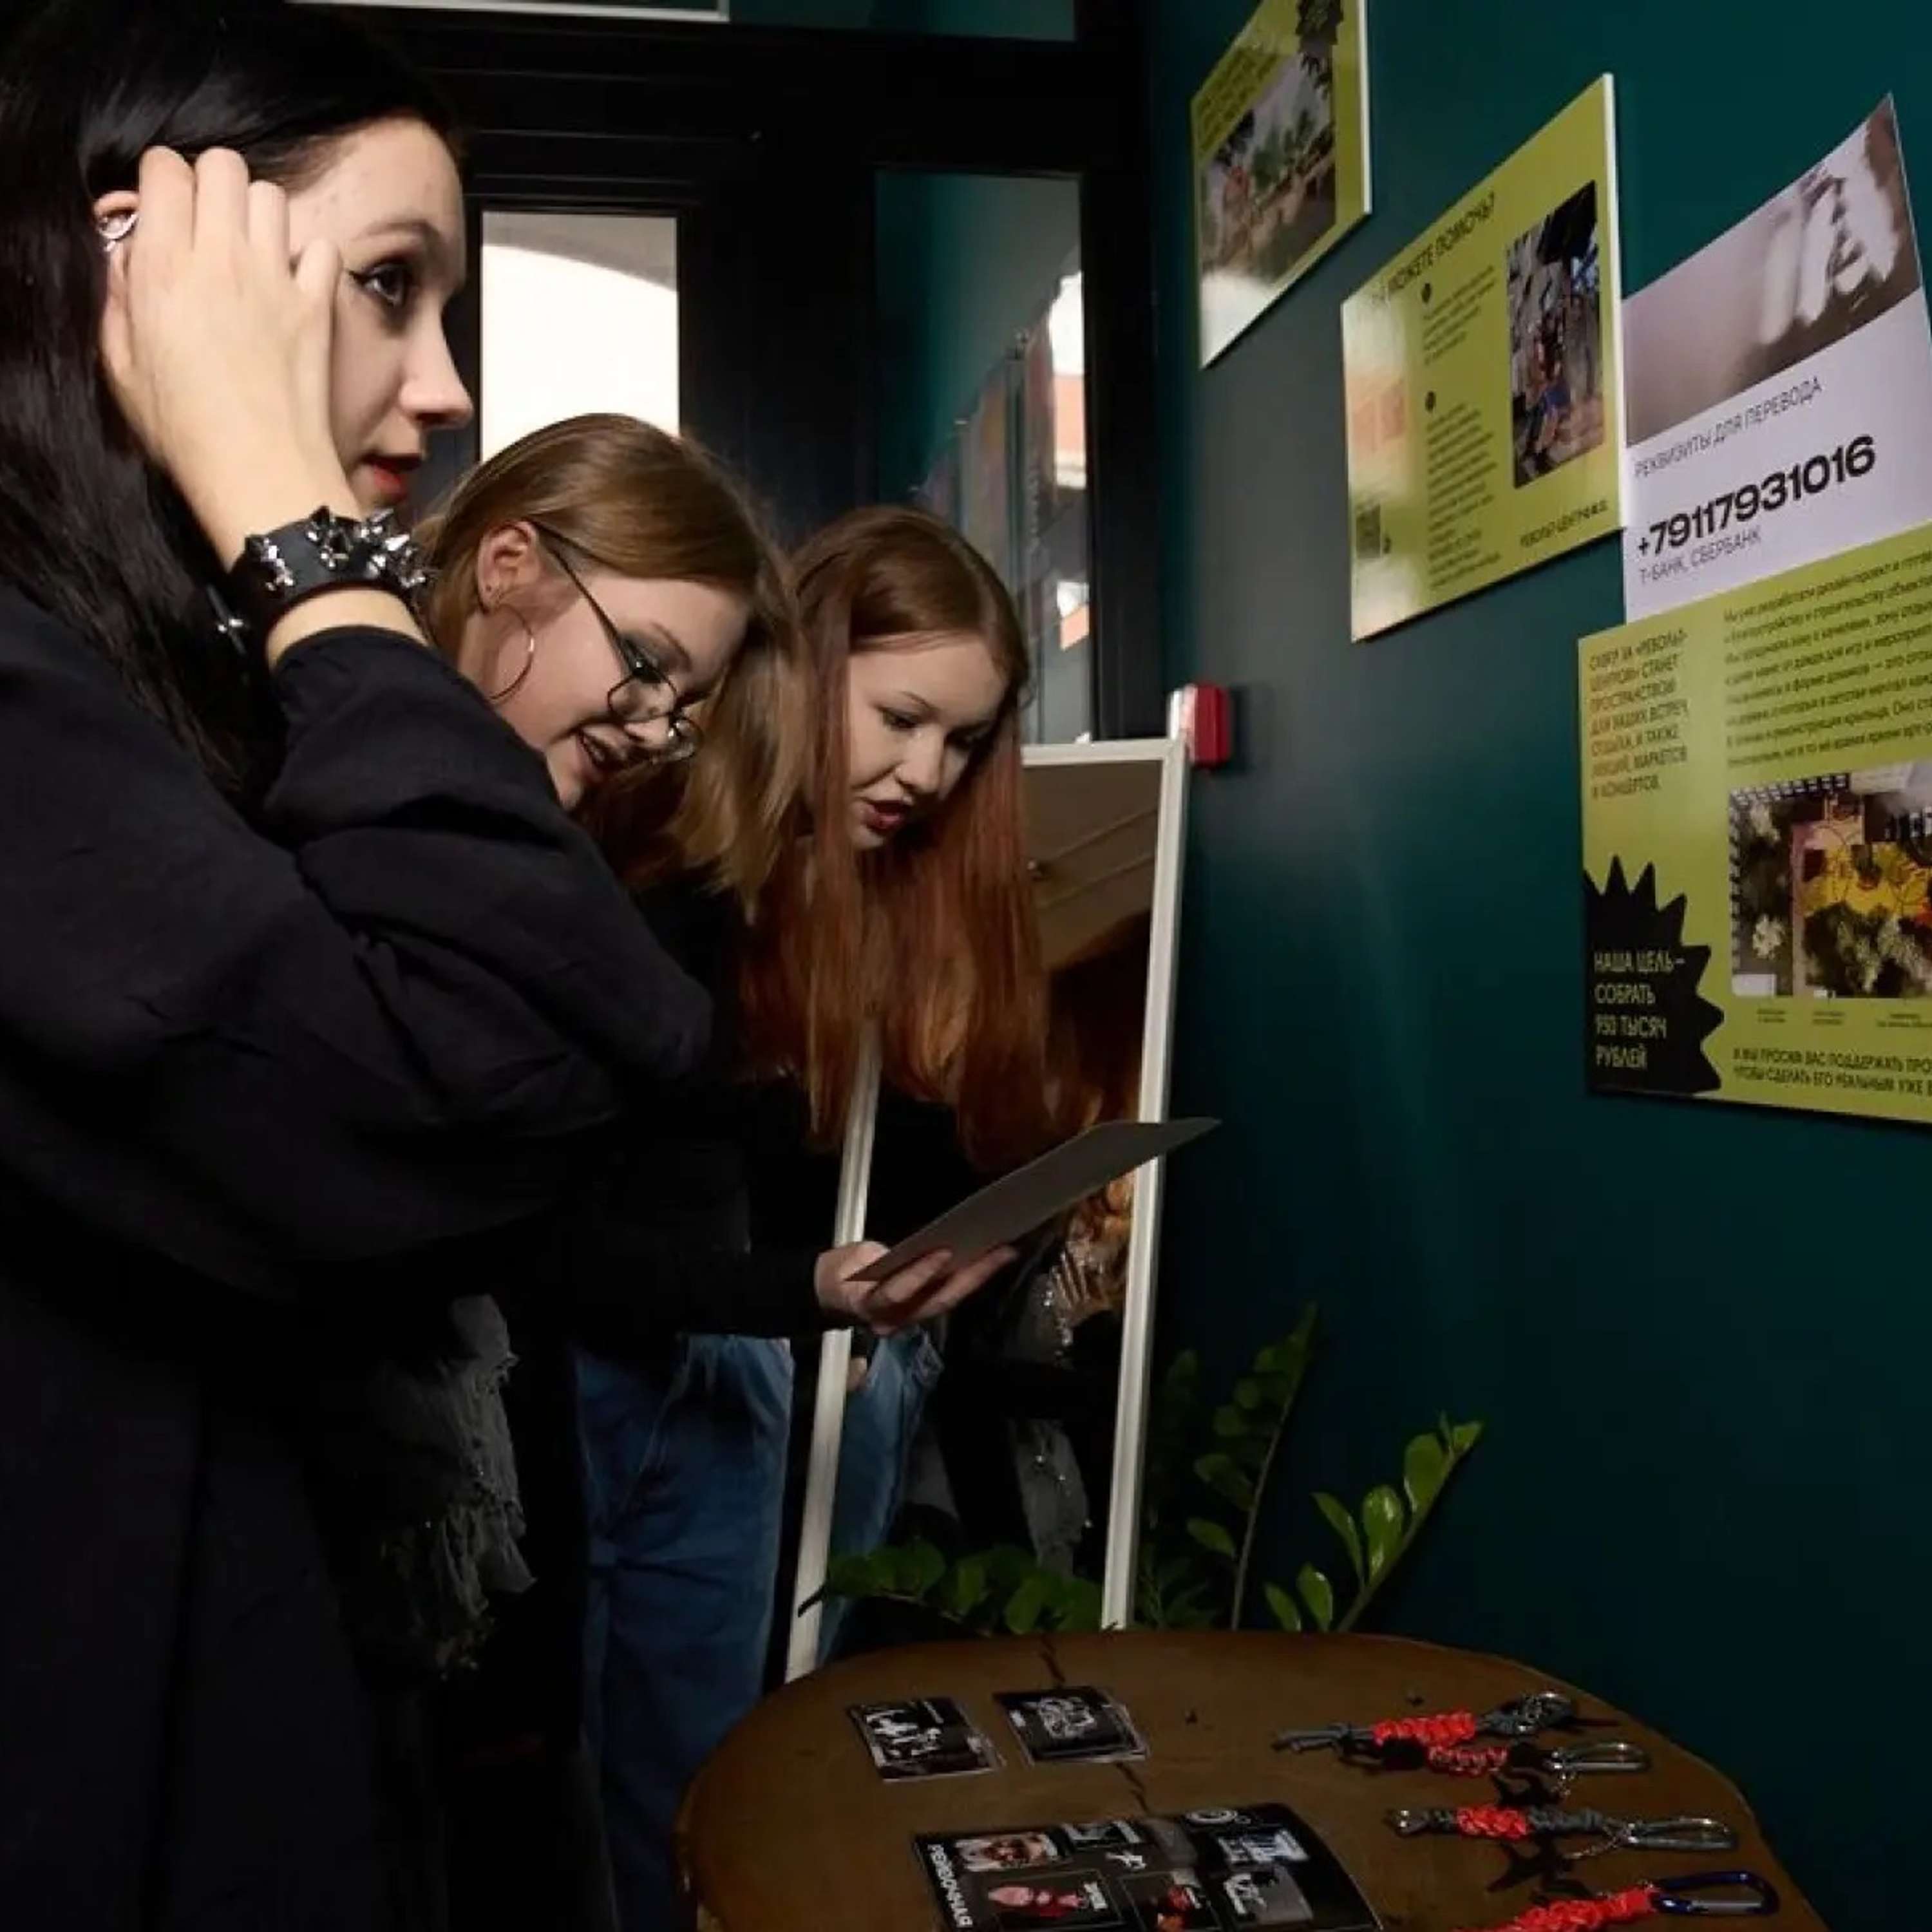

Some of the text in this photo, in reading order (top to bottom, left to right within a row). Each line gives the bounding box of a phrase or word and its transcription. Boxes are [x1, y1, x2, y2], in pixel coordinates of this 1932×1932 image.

[1634, 375, 1823, 478] РЕКВИЗИТЫ ДЛЯ ПЕРЕВОДА
[1638, 434, 1875, 555] +79117931016
[1690, 525, 1762, 566] СБЕРБАНК
[1593, 949, 1633, 973] НАША
[1594, 982, 1656, 1005] СОБРАТЬ
[1620, 1014, 1667, 1039] ТЫСЯЧ
[1595, 1043, 1649, 1070] РУБЛЕЙ
